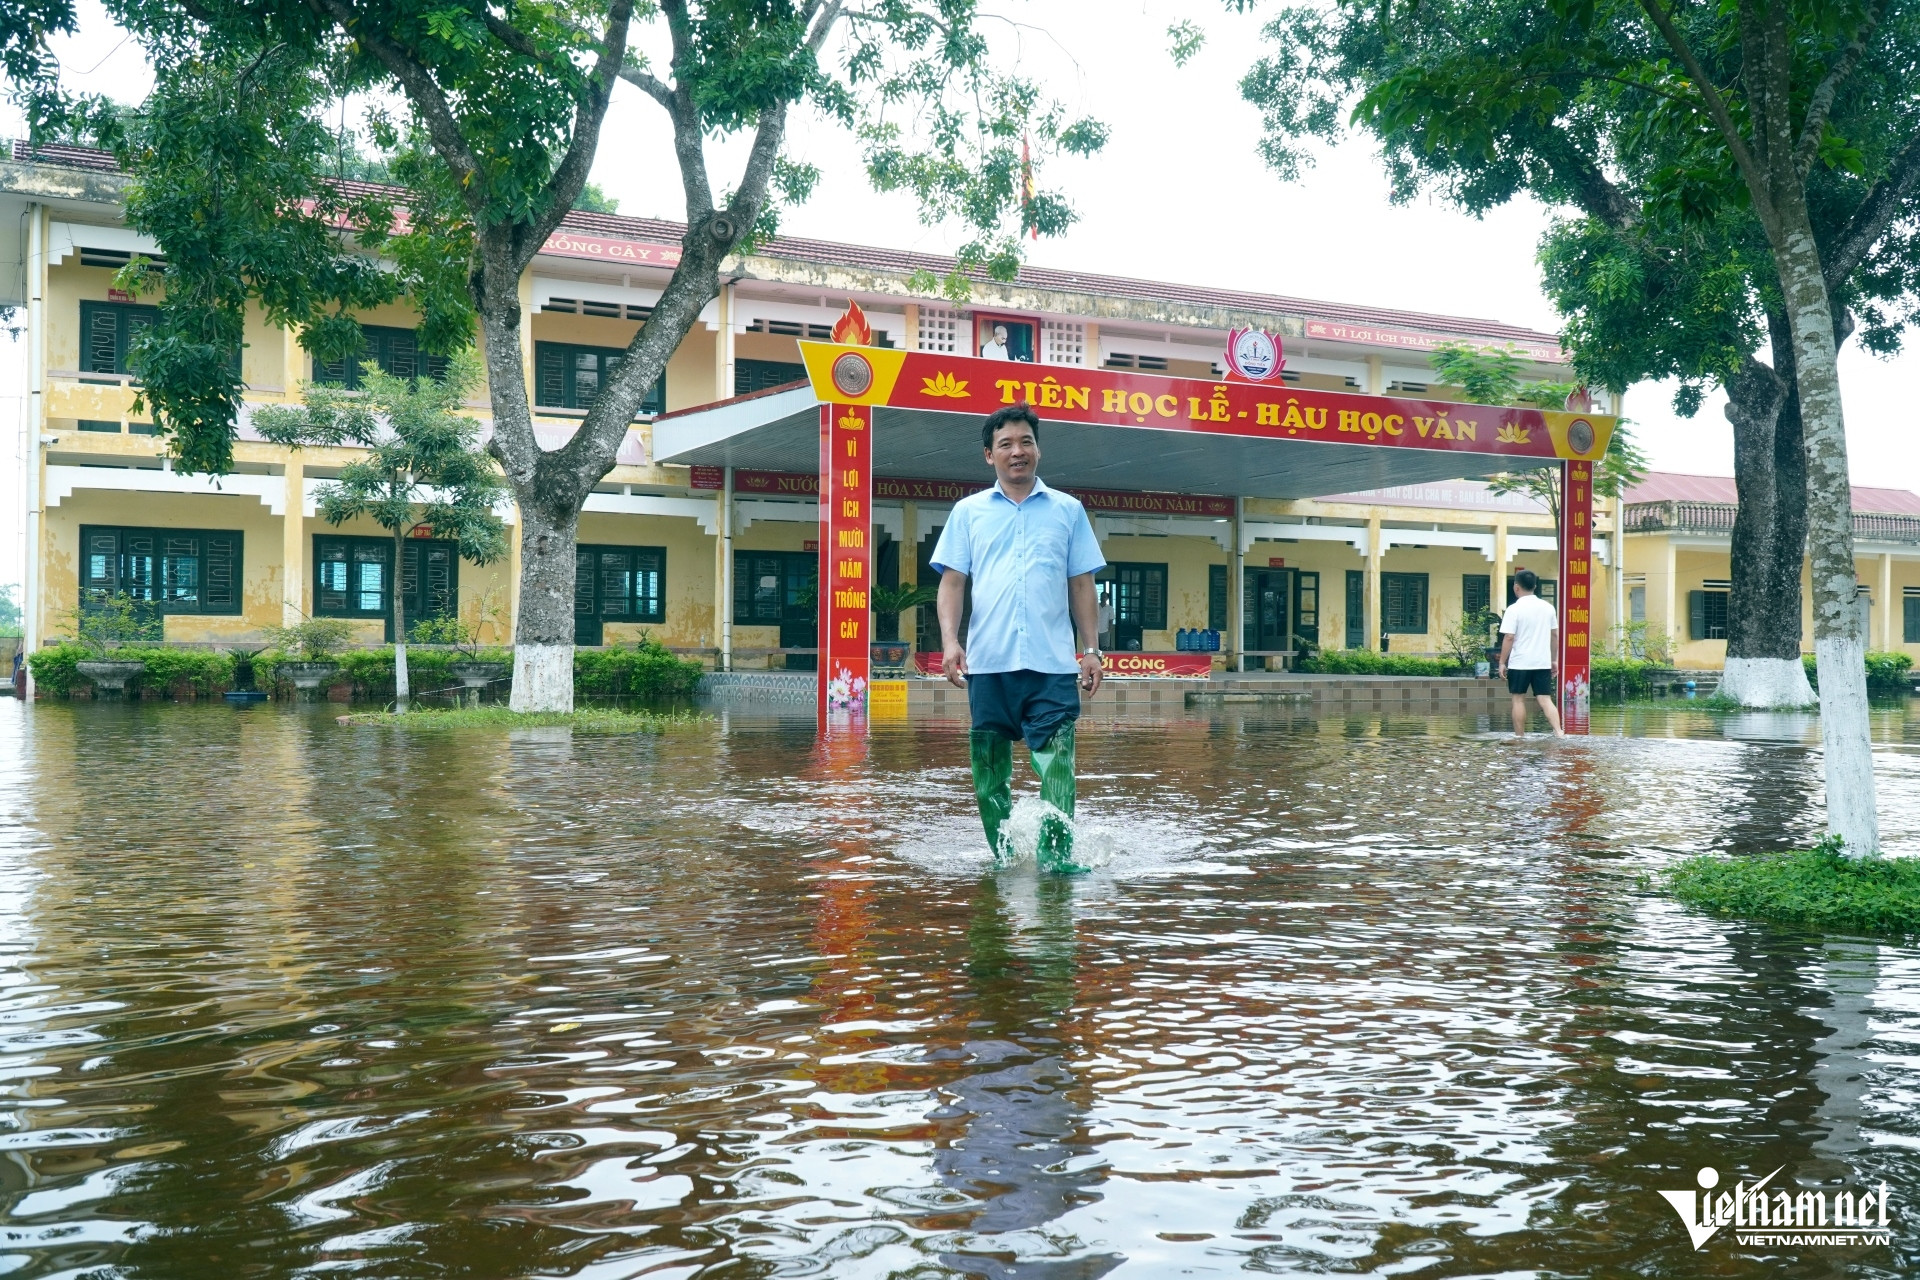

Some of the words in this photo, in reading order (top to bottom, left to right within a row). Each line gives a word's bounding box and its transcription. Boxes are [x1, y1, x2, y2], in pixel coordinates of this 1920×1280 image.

[608, 245, 652, 259] CÂY
[1332, 327, 1346, 337] VÌ
[1350, 330, 1372, 341] LỢI
[1375, 331, 1398, 343] ÍCH
[995, 375, 1091, 410] TIÊN
[1101, 389, 1178, 423] HỌC
[1187, 385, 1231, 422] LỄ
[1237, 410, 1248, 418] -
[1255, 398, 1328, 435] HẬU
[1337, 409, 1404, 441] HỌC
[1412, 411, 1478, 442] VĂN
[846, 437, 857, 457] VÌ
[843, 469, 859, 490] LỢI
[876, 480, 909, 496] HÒA
[912, 482, 935, 497] XÃ
[938, 483, 965, 501] HỘI
[1576, 486, 1584, 502] VÌ
[842, 497, 859, 517] ÍCH
[1088, 494, 1119, 508] NAM
[1122, 495, 1162, 510] MUÔN
[1166, 496, 1196, 511] NĂM
[1574, 511, 1585, 529] LỢI
[839, 526, 864, 548] MƯỜI
[1574, 536, 1585, 551] ÍCH
[839, 558, 862, 579] NĂM
[1569, 558, 1587, 574] TRĂM
[835, 586, 866, 609] TRỒNG
[1571, 582, 1587, 599] NĂM
[840, 618, 859, 639] CÂY
[1568, 629, 1587, 648] NGƯỜI
[1118, 656, 1165, 669] CÔNG
